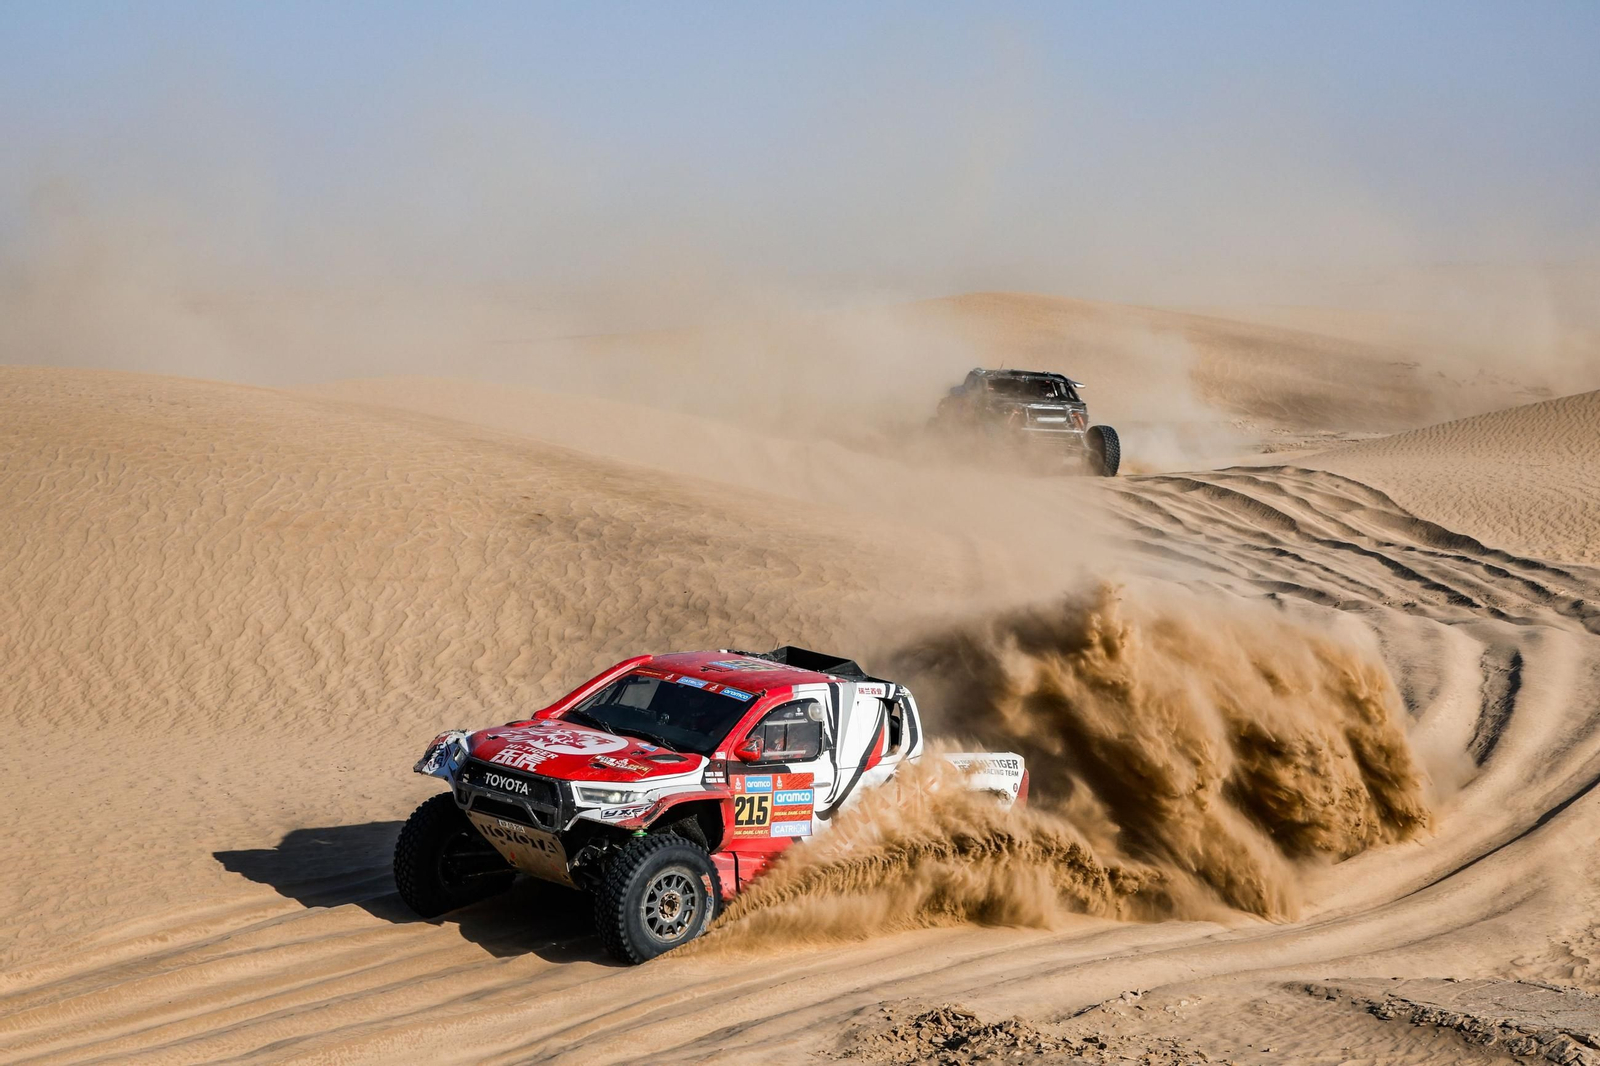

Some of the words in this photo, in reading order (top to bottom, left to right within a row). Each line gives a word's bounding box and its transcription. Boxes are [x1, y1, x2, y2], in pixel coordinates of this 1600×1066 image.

[724, 689, 748, 699] aramco
[505, 743, 559, 759] HI-TIGER
[485, 772, 529, 795] TOYOTA
[747, 780, 771, 788] aramco
[776, 792, 810, 802] aramco
[735, 796, 768, 826] 215
[775, 823, 807, 834] CATRION
